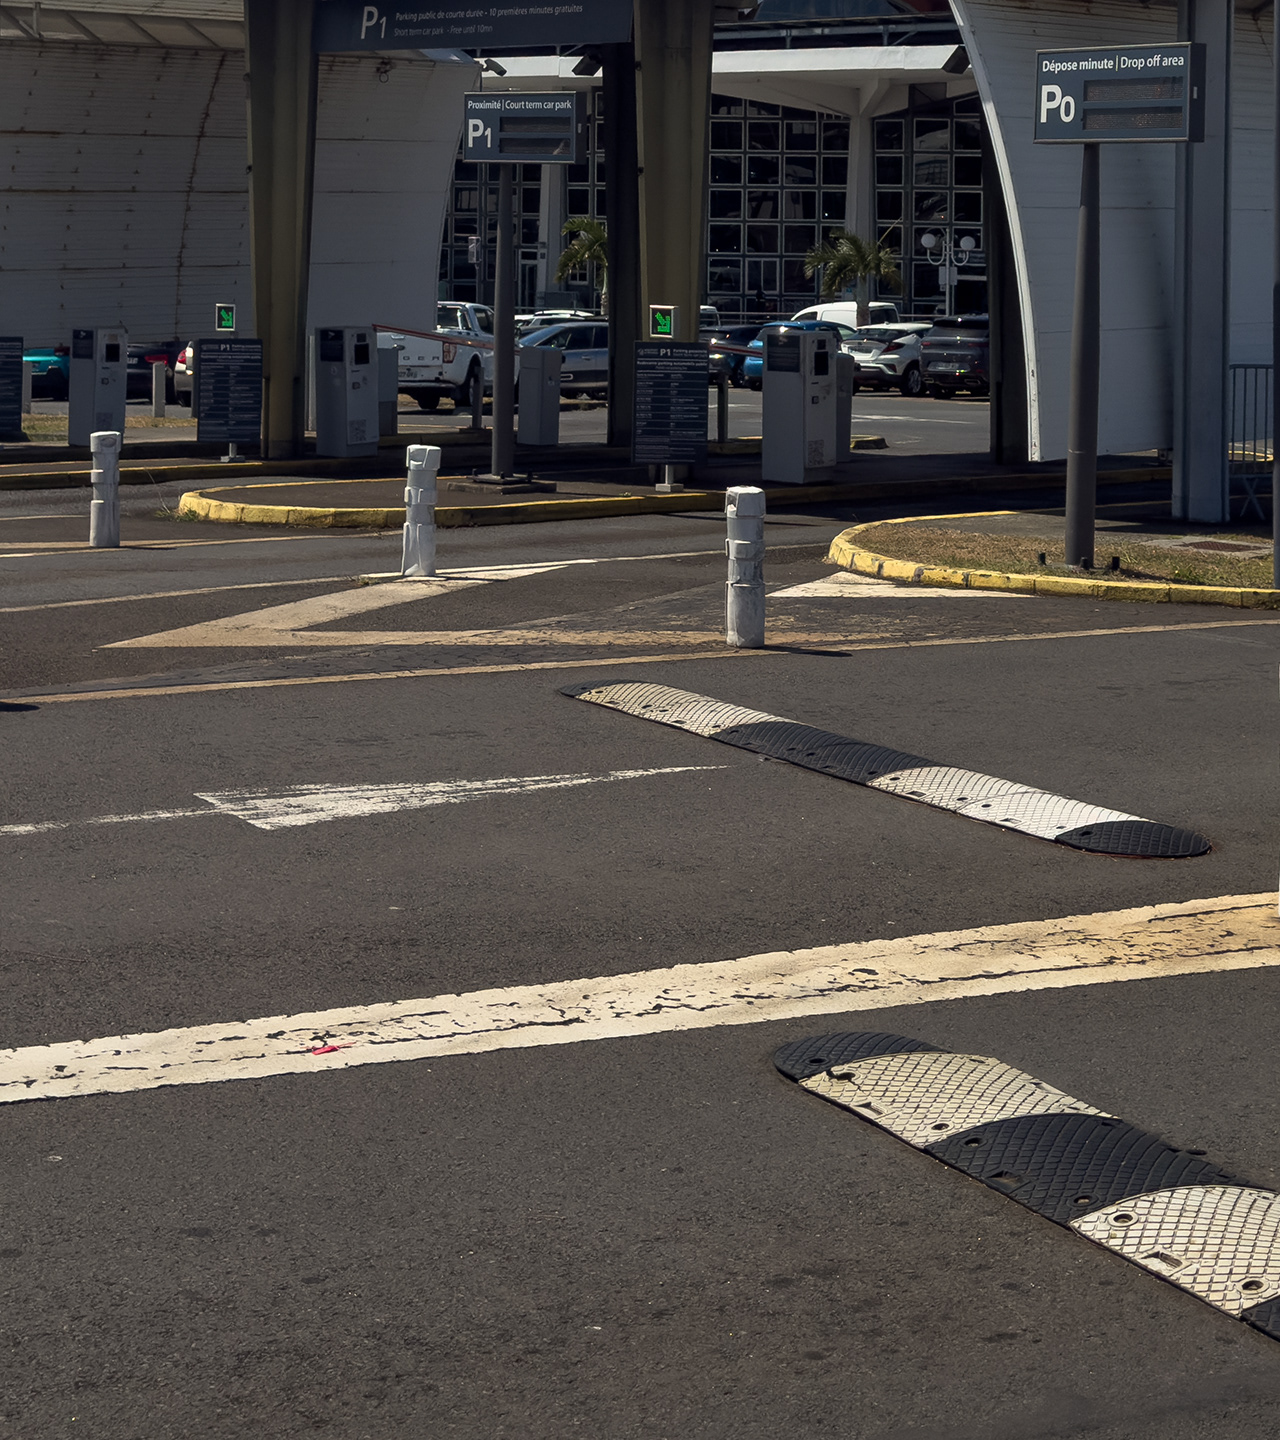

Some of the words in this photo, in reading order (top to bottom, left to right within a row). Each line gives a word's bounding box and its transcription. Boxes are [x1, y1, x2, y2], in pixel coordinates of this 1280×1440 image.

[396, 12, 417, 22] Parking
[418, 11, 436, 21] public
[437, 11, 445, 19] de
[446, 11, 464, 19] courte
[466, 9, 483, 18] durée
[490, 8, 497, 16] 10
[529, 5, 553, 14] minutes
[554, 4, 583, 16] gratuites
[360, 6, 386, 40] P1
[394, 28, 408, 36] Short
[432, 27, 444, 36] park
[463, 25, 476, 33] until
[1042, 60, 1077, 74] Dépose
[1079, 58, 1114, 70] minute
[1120, 56, 1145, 70] Drop
[1146, 55, 1161, 66] off
[1162, 56, 1184, 66] area
[468, 100, 501, 109] Proximité
[505, 100, 524, 109] Court
[525, 101, 542, 109] term
[555, 100, 571, 111] park
[468, 119, 492, 148] P1
